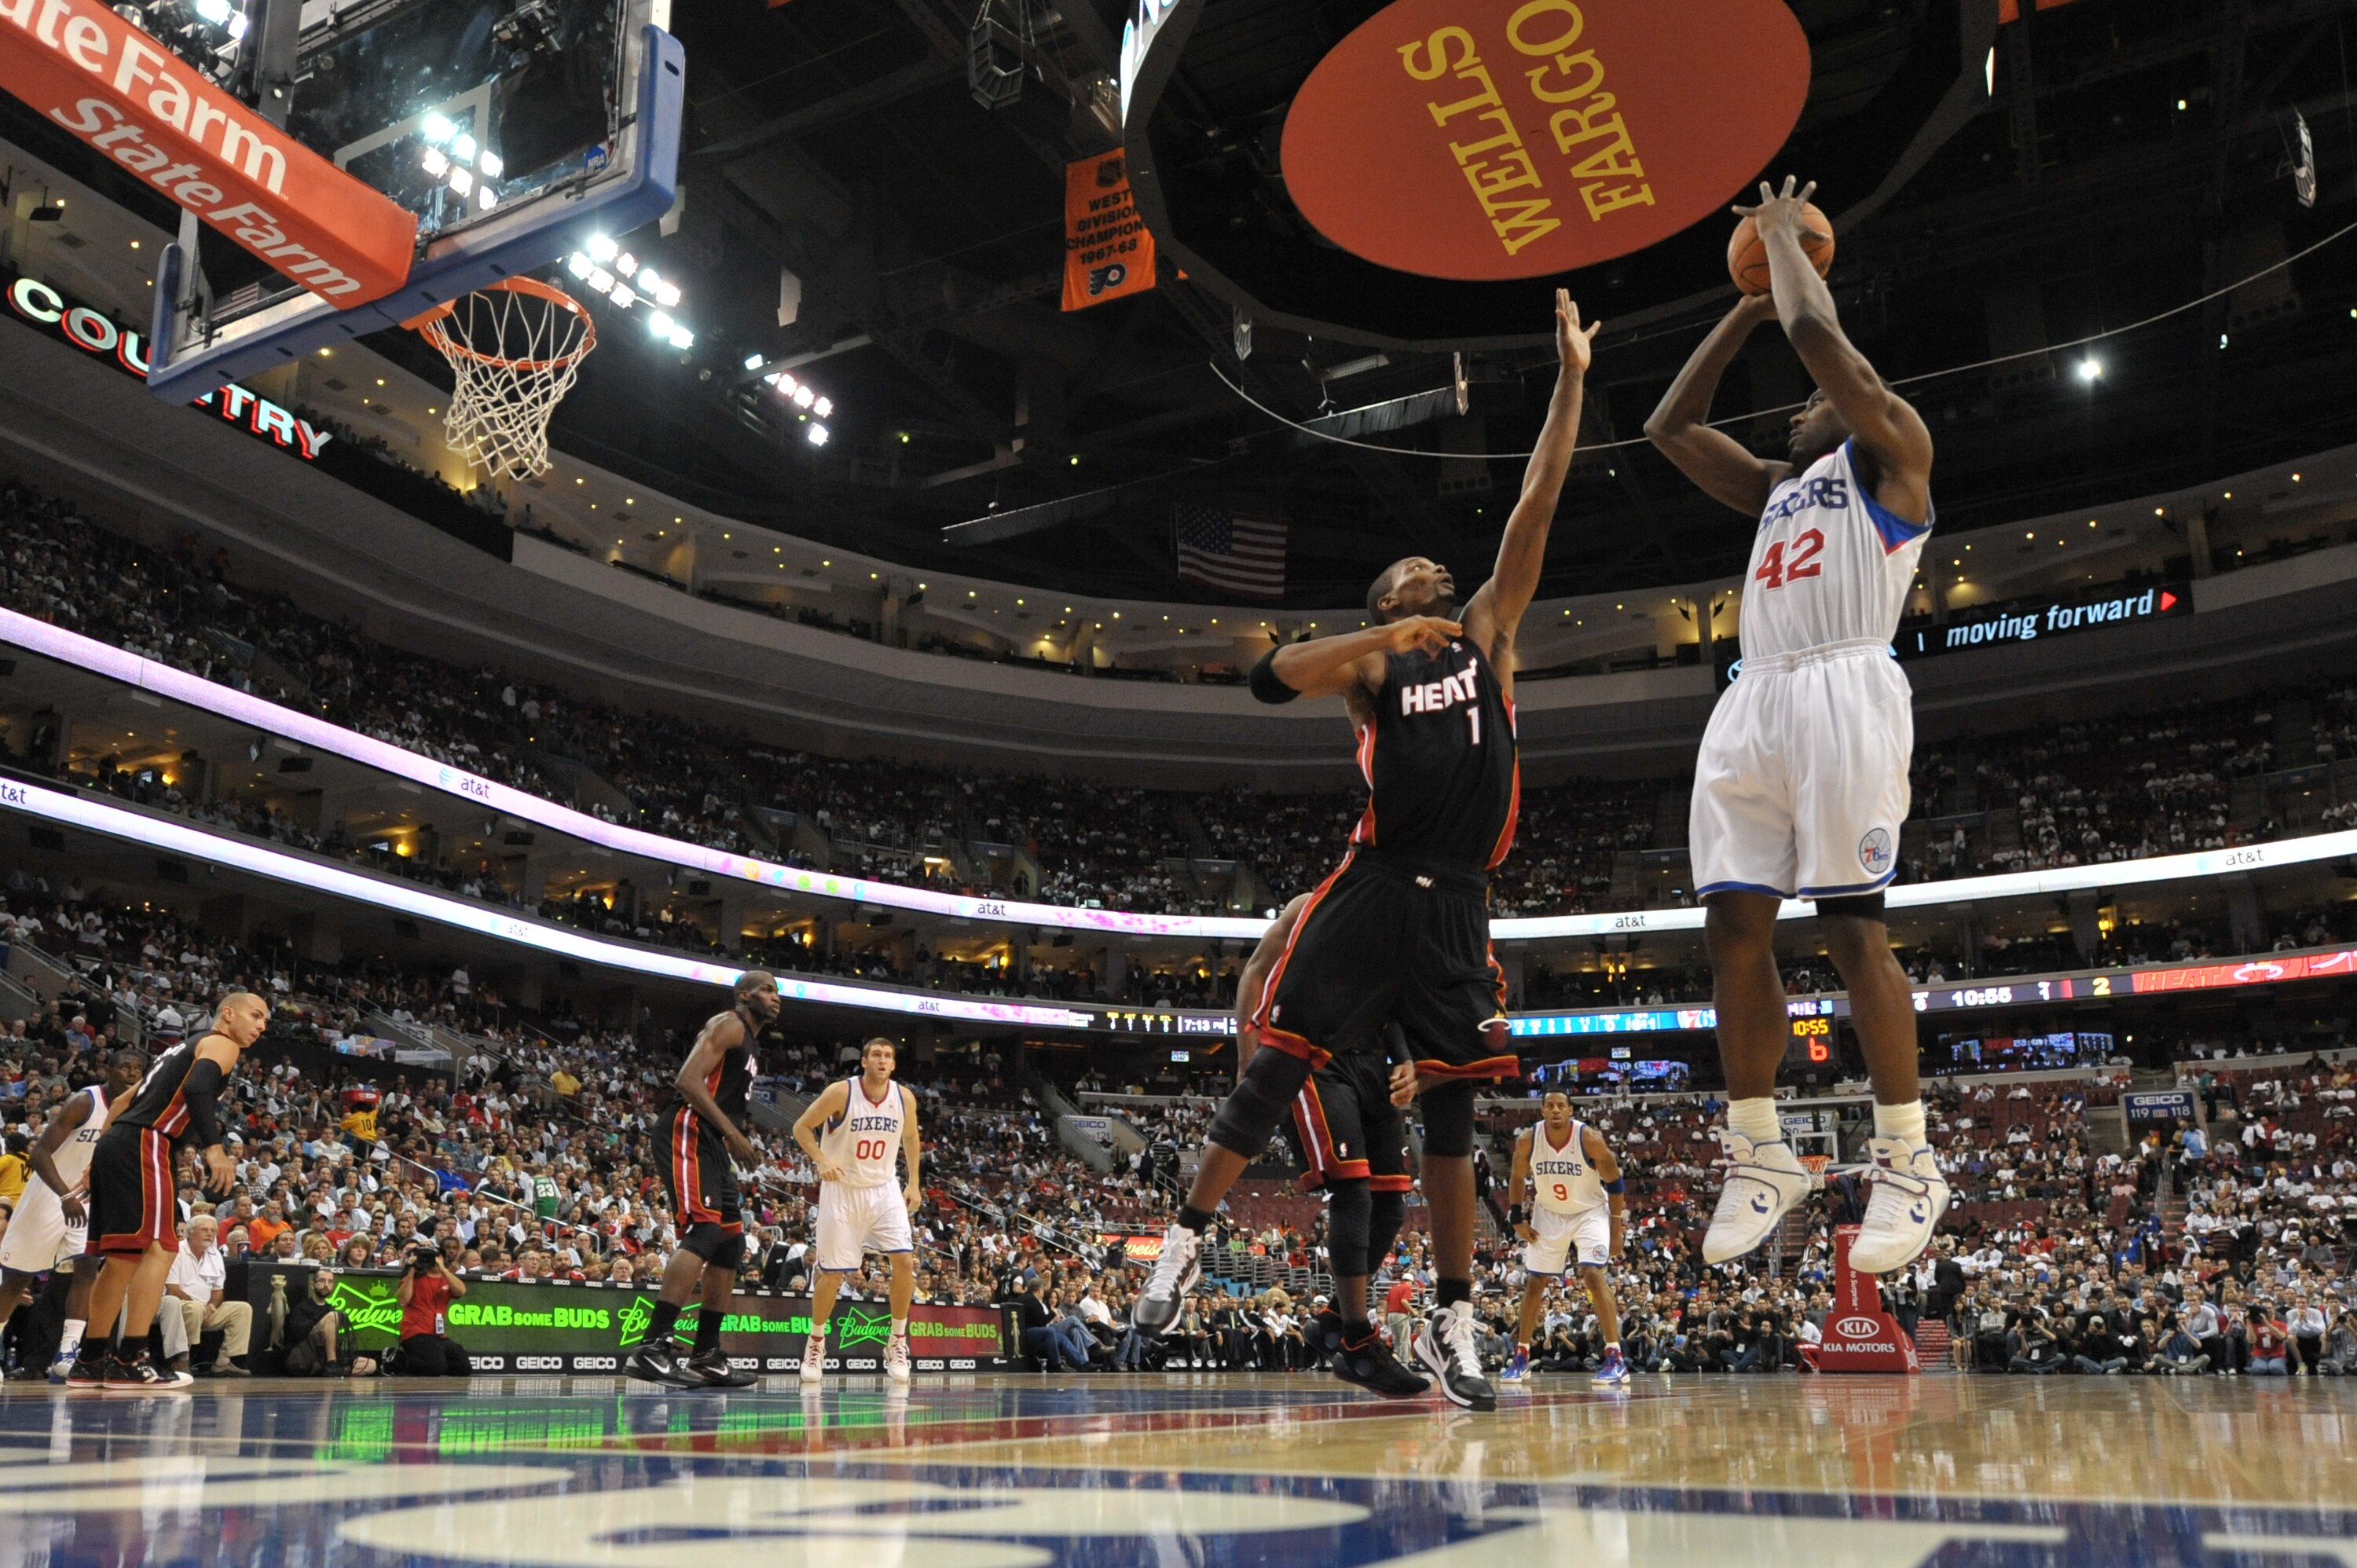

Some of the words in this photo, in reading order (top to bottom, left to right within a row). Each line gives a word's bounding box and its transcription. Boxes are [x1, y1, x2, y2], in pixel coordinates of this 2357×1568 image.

[113, 35, 287, 196] Farm
[1506, 0, 1656, 222] FARGO
[1396, 26, 1562, 255] WELLS
[50, 98, 223, 207] State
[207, 202, 361, 296] Farm
[1089, 189, 1130, 213] WEST
[1077, 206, 1136, 233] DIVISIO
[1080, 239, 1137, 264] 1967-68
[7, 278, 333, 459] COUTRY
[1755, 527, 1826, 591] 42
[1946, 614, 2039, 647] moving
[2047, 589, 2154, 630] forward
[1402, 658, 1478, 716] HEAT
[1467, 707, 1480, 745] 1
[1, 782, 27, 804] t&t
[460, 778, 490, 799] at&t
[2226, 848, 2264, 866] at&t
[977, 903, 1006, 916] at&t
[1615, 915, 1646, 928] at&t
[2093, 976, 2111, 995] 2
[2142, 966, 2223, 990] HEAT
[1952, 987, 2012, 1006] 10:55
[918, 1001, 940, 1012] at&t
[1185, 1019, 1210, 1031] 7:13
[1793, 1019, 1829, 1036] 10:55
[2132, 1094, 2184, 1106] GEICO
[2130, 1108, 2149, 1118] 119
[2171, 1105, 2190, 1116] 118
[362, 1119, 372, 1131] 10
[850, 1116, 898, 1133] SIXERS
[1097, 1132, 1109, 1141] 121
[856, 1140, 886, 1160] 00
[1536, 1161, 1582, 1176] SIXERS
[536, 1184, 555, 1197] 23
[1552, 1183, 1567, 1201] 9
[448, 1304, 512, 1325] GRAB
[513, 1313, 552, 1326] SOME
[554, 1308, 610, 1328] BUDS
[719, 1315, 761, 1332] GRAB
[762, 1321, 790, 1332] SOME
[791, 1317, 832, 1334] BUS
[837, 1317, 892, 1337] Budwei
[909, 1321, 944, 1337] GRAB
[944, 1328, 966, 1337] SOME
[966, 1324, 997, 1339] BUDS
[1844, 1323, 1871, 1333] KIA
[1823, 1343, 1843, 1352] KIA
[1846, 1343, 1896, 1353] MOTORS
[468, 1357, 504, 1369] EICO
[516, 1357, 563, 1369] GEICO
[574, 1357, 617, 1369] GEICO
[767, 1358, 801, 1369] GEICO
[822, 1359, 840, 1369] ICO
[846, 1359, 877, 1369] GEICO
[917, 1360, 944, 1369] GEICO
[950, 1360, 976, 1369] GEICO
